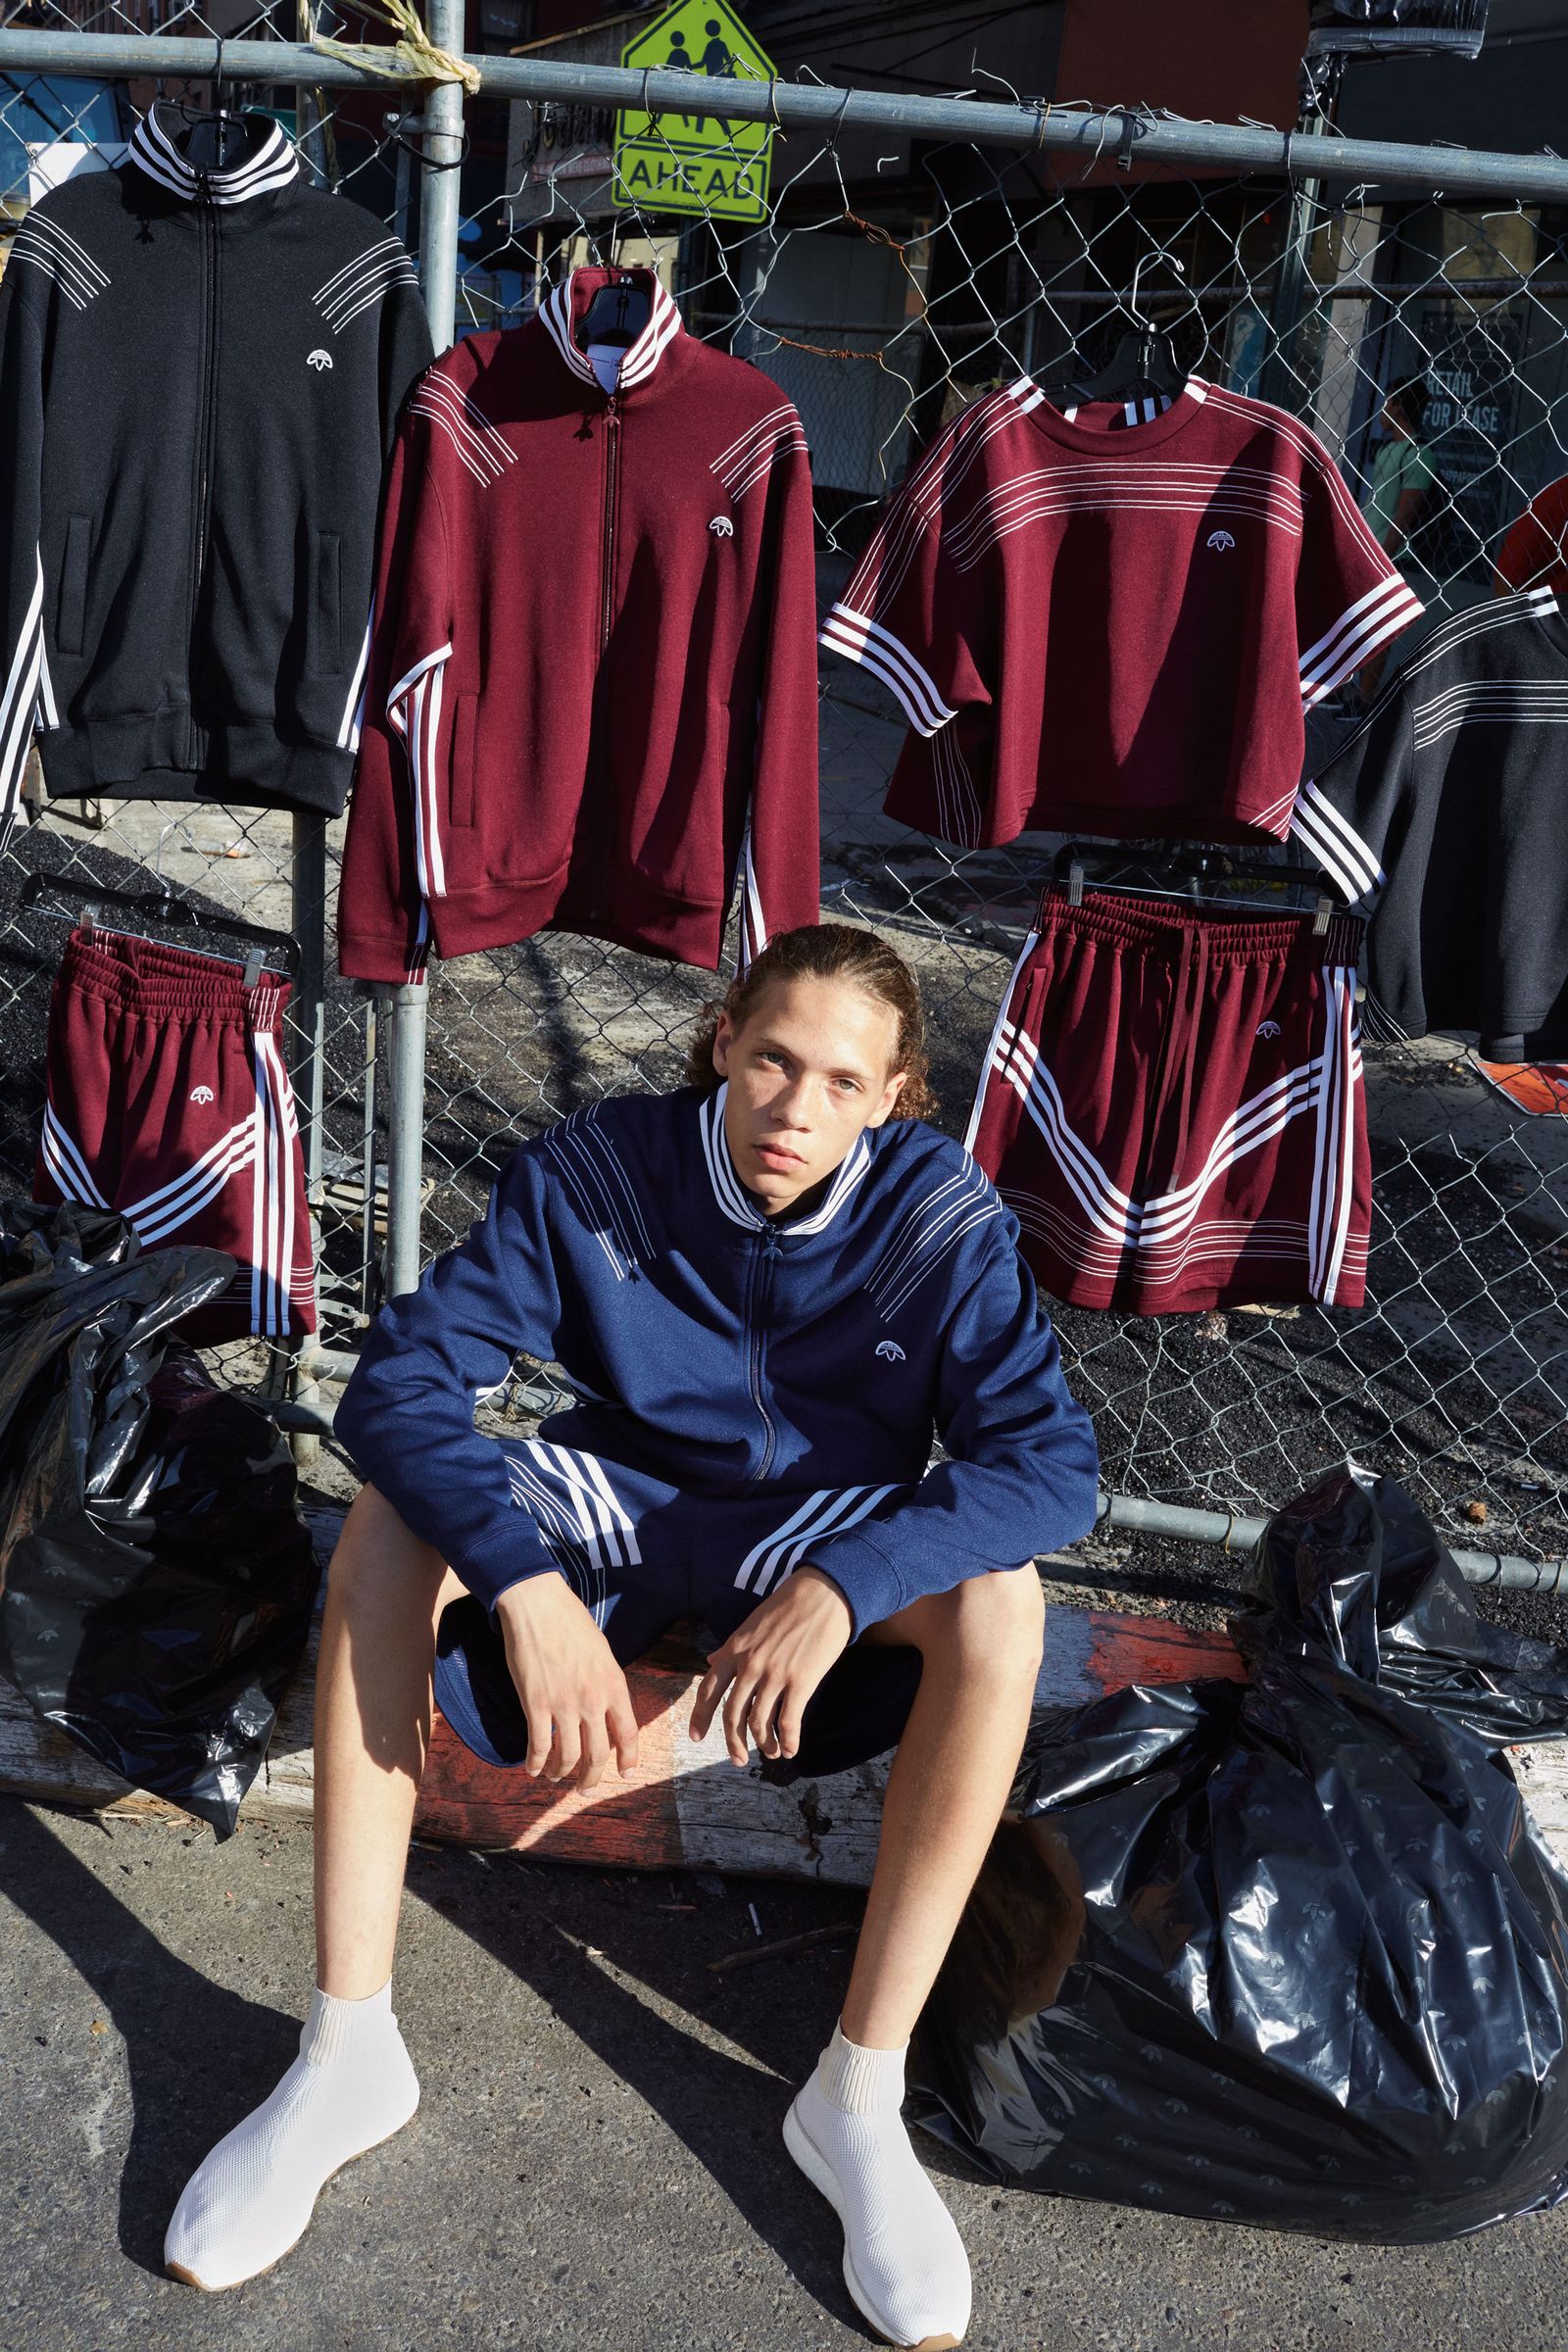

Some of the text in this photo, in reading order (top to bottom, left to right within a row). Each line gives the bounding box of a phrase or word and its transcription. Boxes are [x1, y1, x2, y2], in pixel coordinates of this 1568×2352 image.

[627, 159, 755, 201] AHEAD
[1426, 370, 1473, 398] RETAIL
[1422, 401, 1499, 432] FOR LEASE
